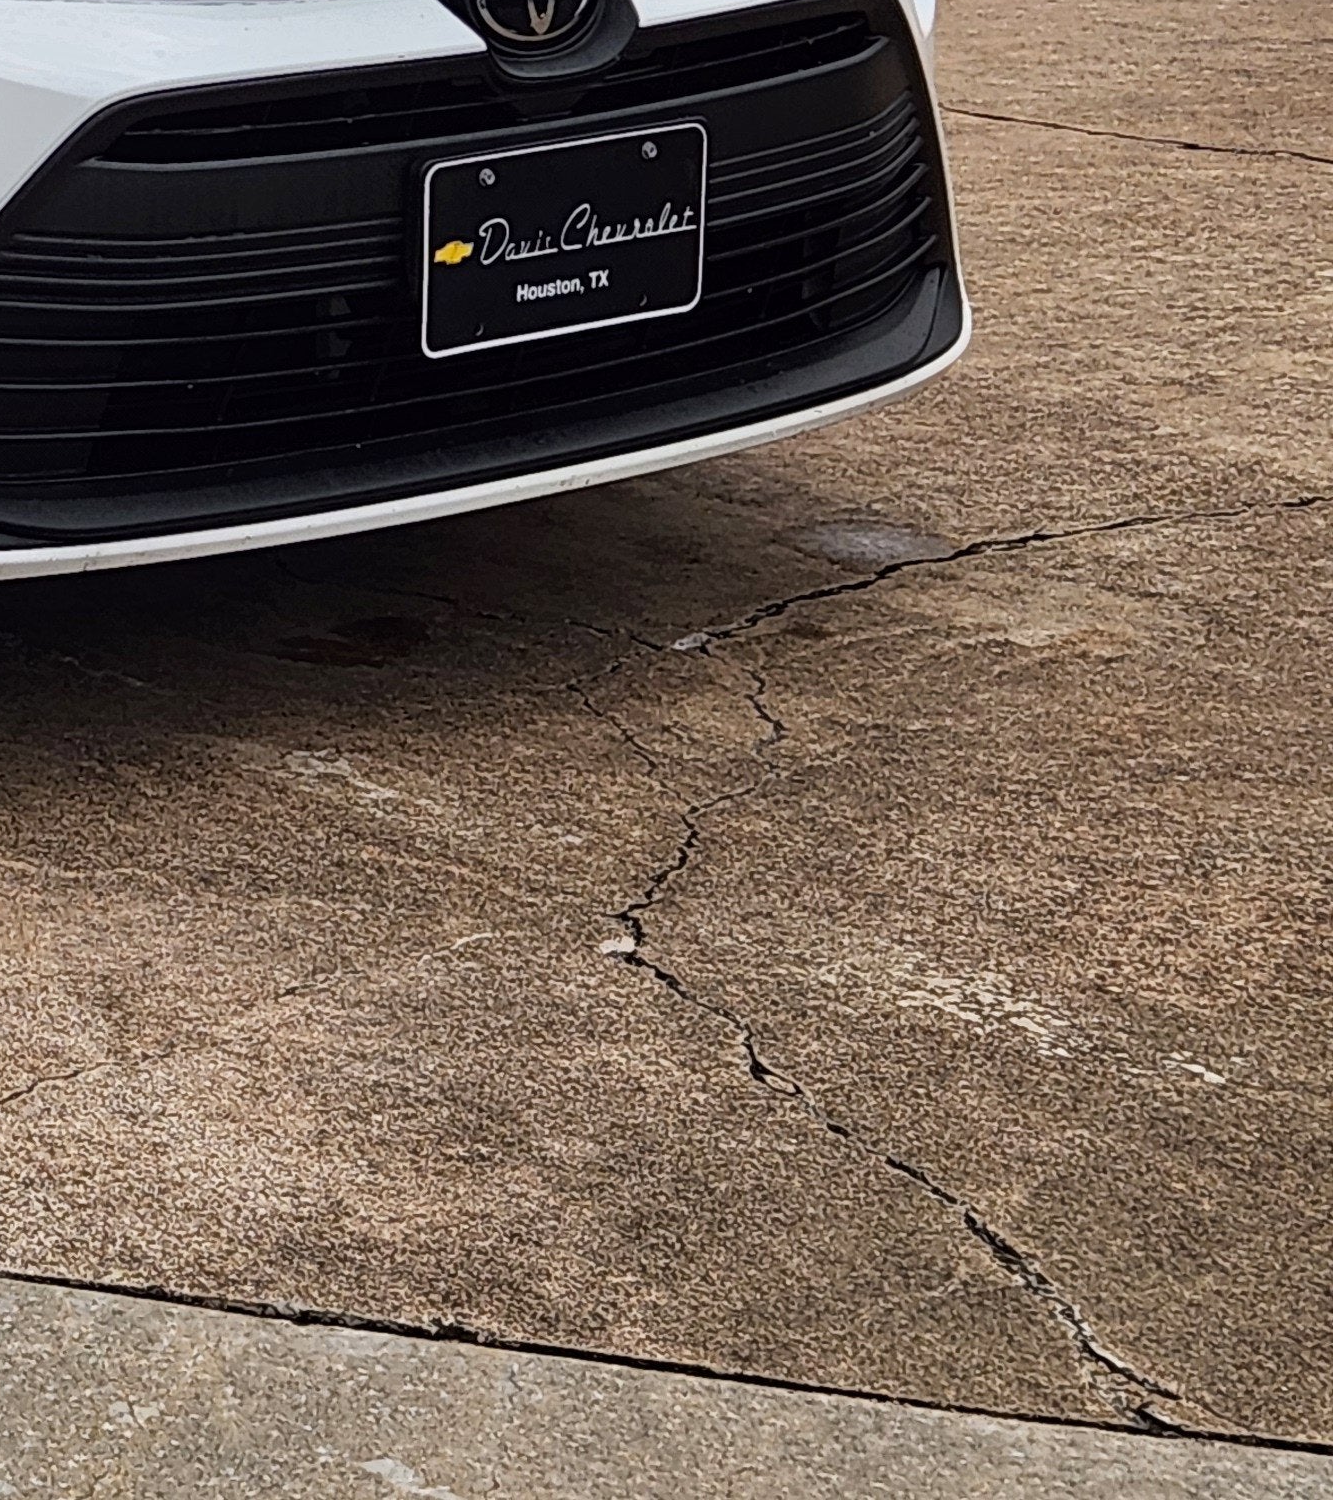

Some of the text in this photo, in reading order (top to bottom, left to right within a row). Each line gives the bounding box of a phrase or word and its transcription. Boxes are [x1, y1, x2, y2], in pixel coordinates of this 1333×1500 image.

[560, 202, 697, 250] Chevrolet
[516, 269, 610, 303] Houston, TX
